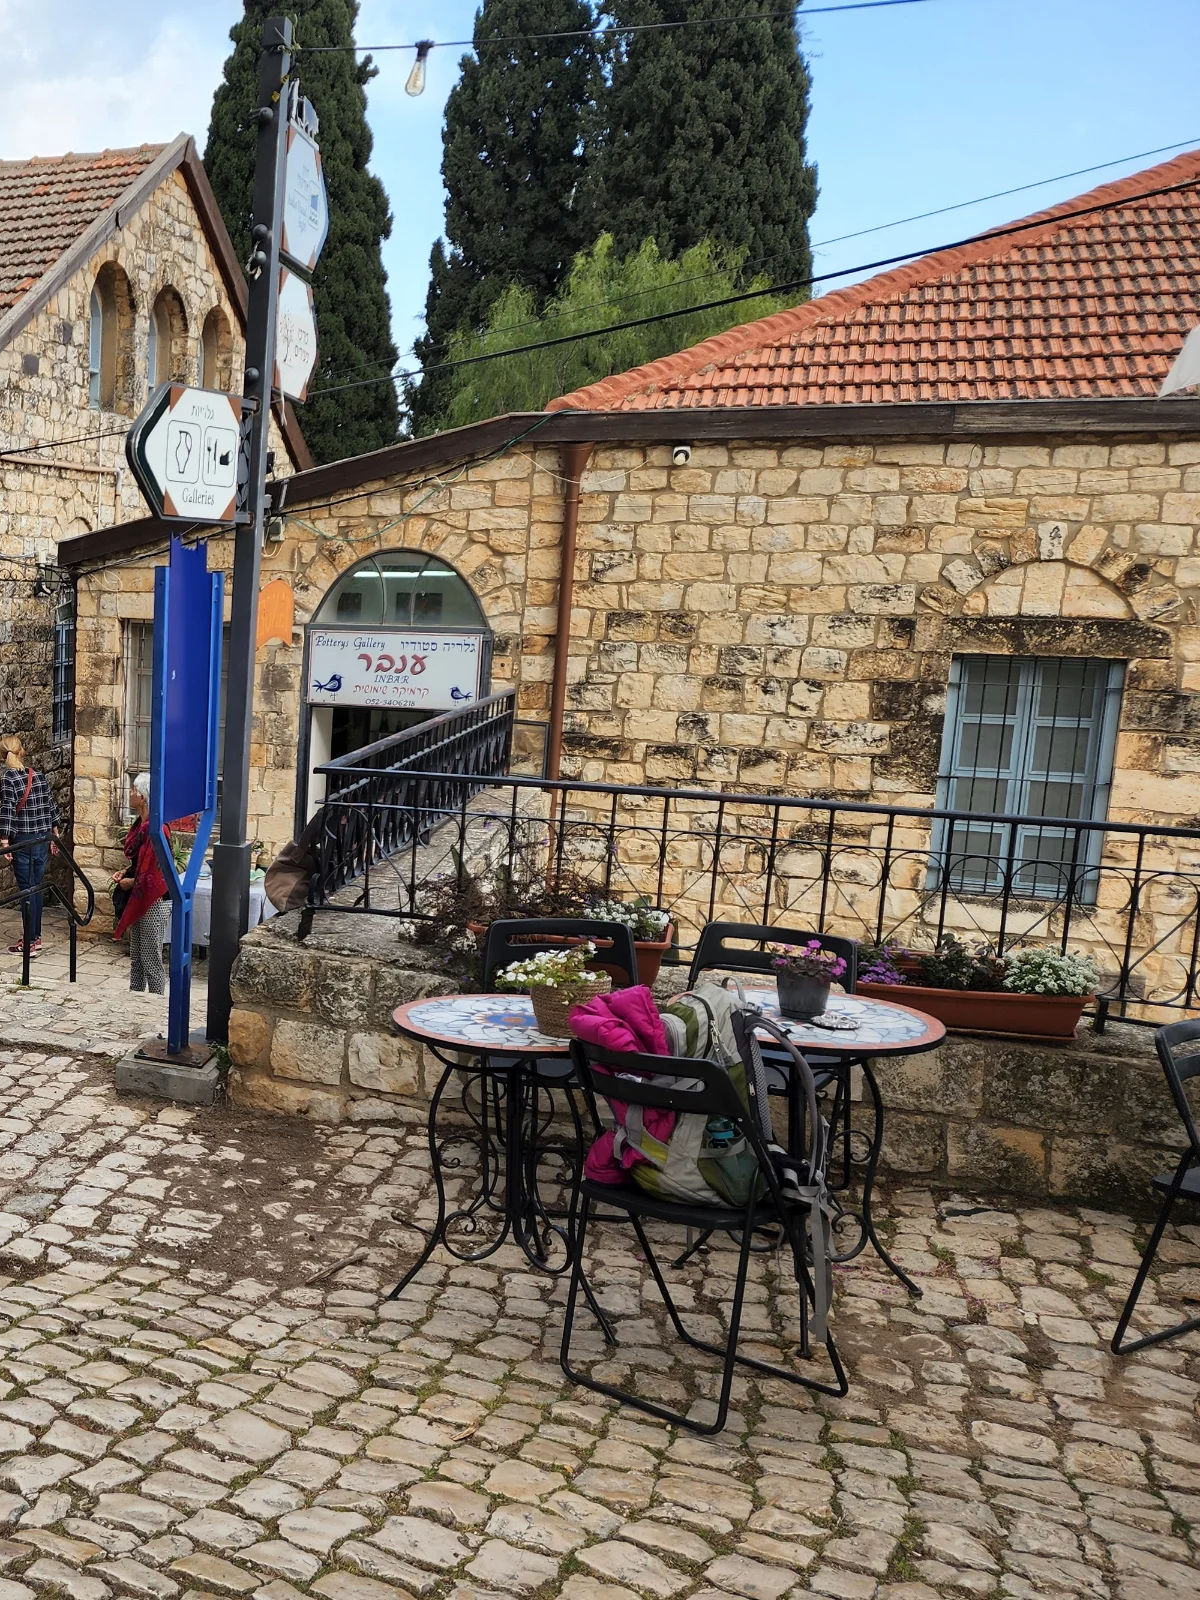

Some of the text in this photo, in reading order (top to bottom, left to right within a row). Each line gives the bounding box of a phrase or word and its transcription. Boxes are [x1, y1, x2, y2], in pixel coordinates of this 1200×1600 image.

[182, 487, 215, 505] Galleries
[315, 635, 386, 651] Potterys Gallery
[400, 639, 476, 653] גלריה סטודיו
[357, 653, 429, 676] ענבר
[374, 674, 410, 684] INBAR
[353, 684, 430, 699] קרמיקה שימושית
[365, 698, 416, 707] 052-3406218
